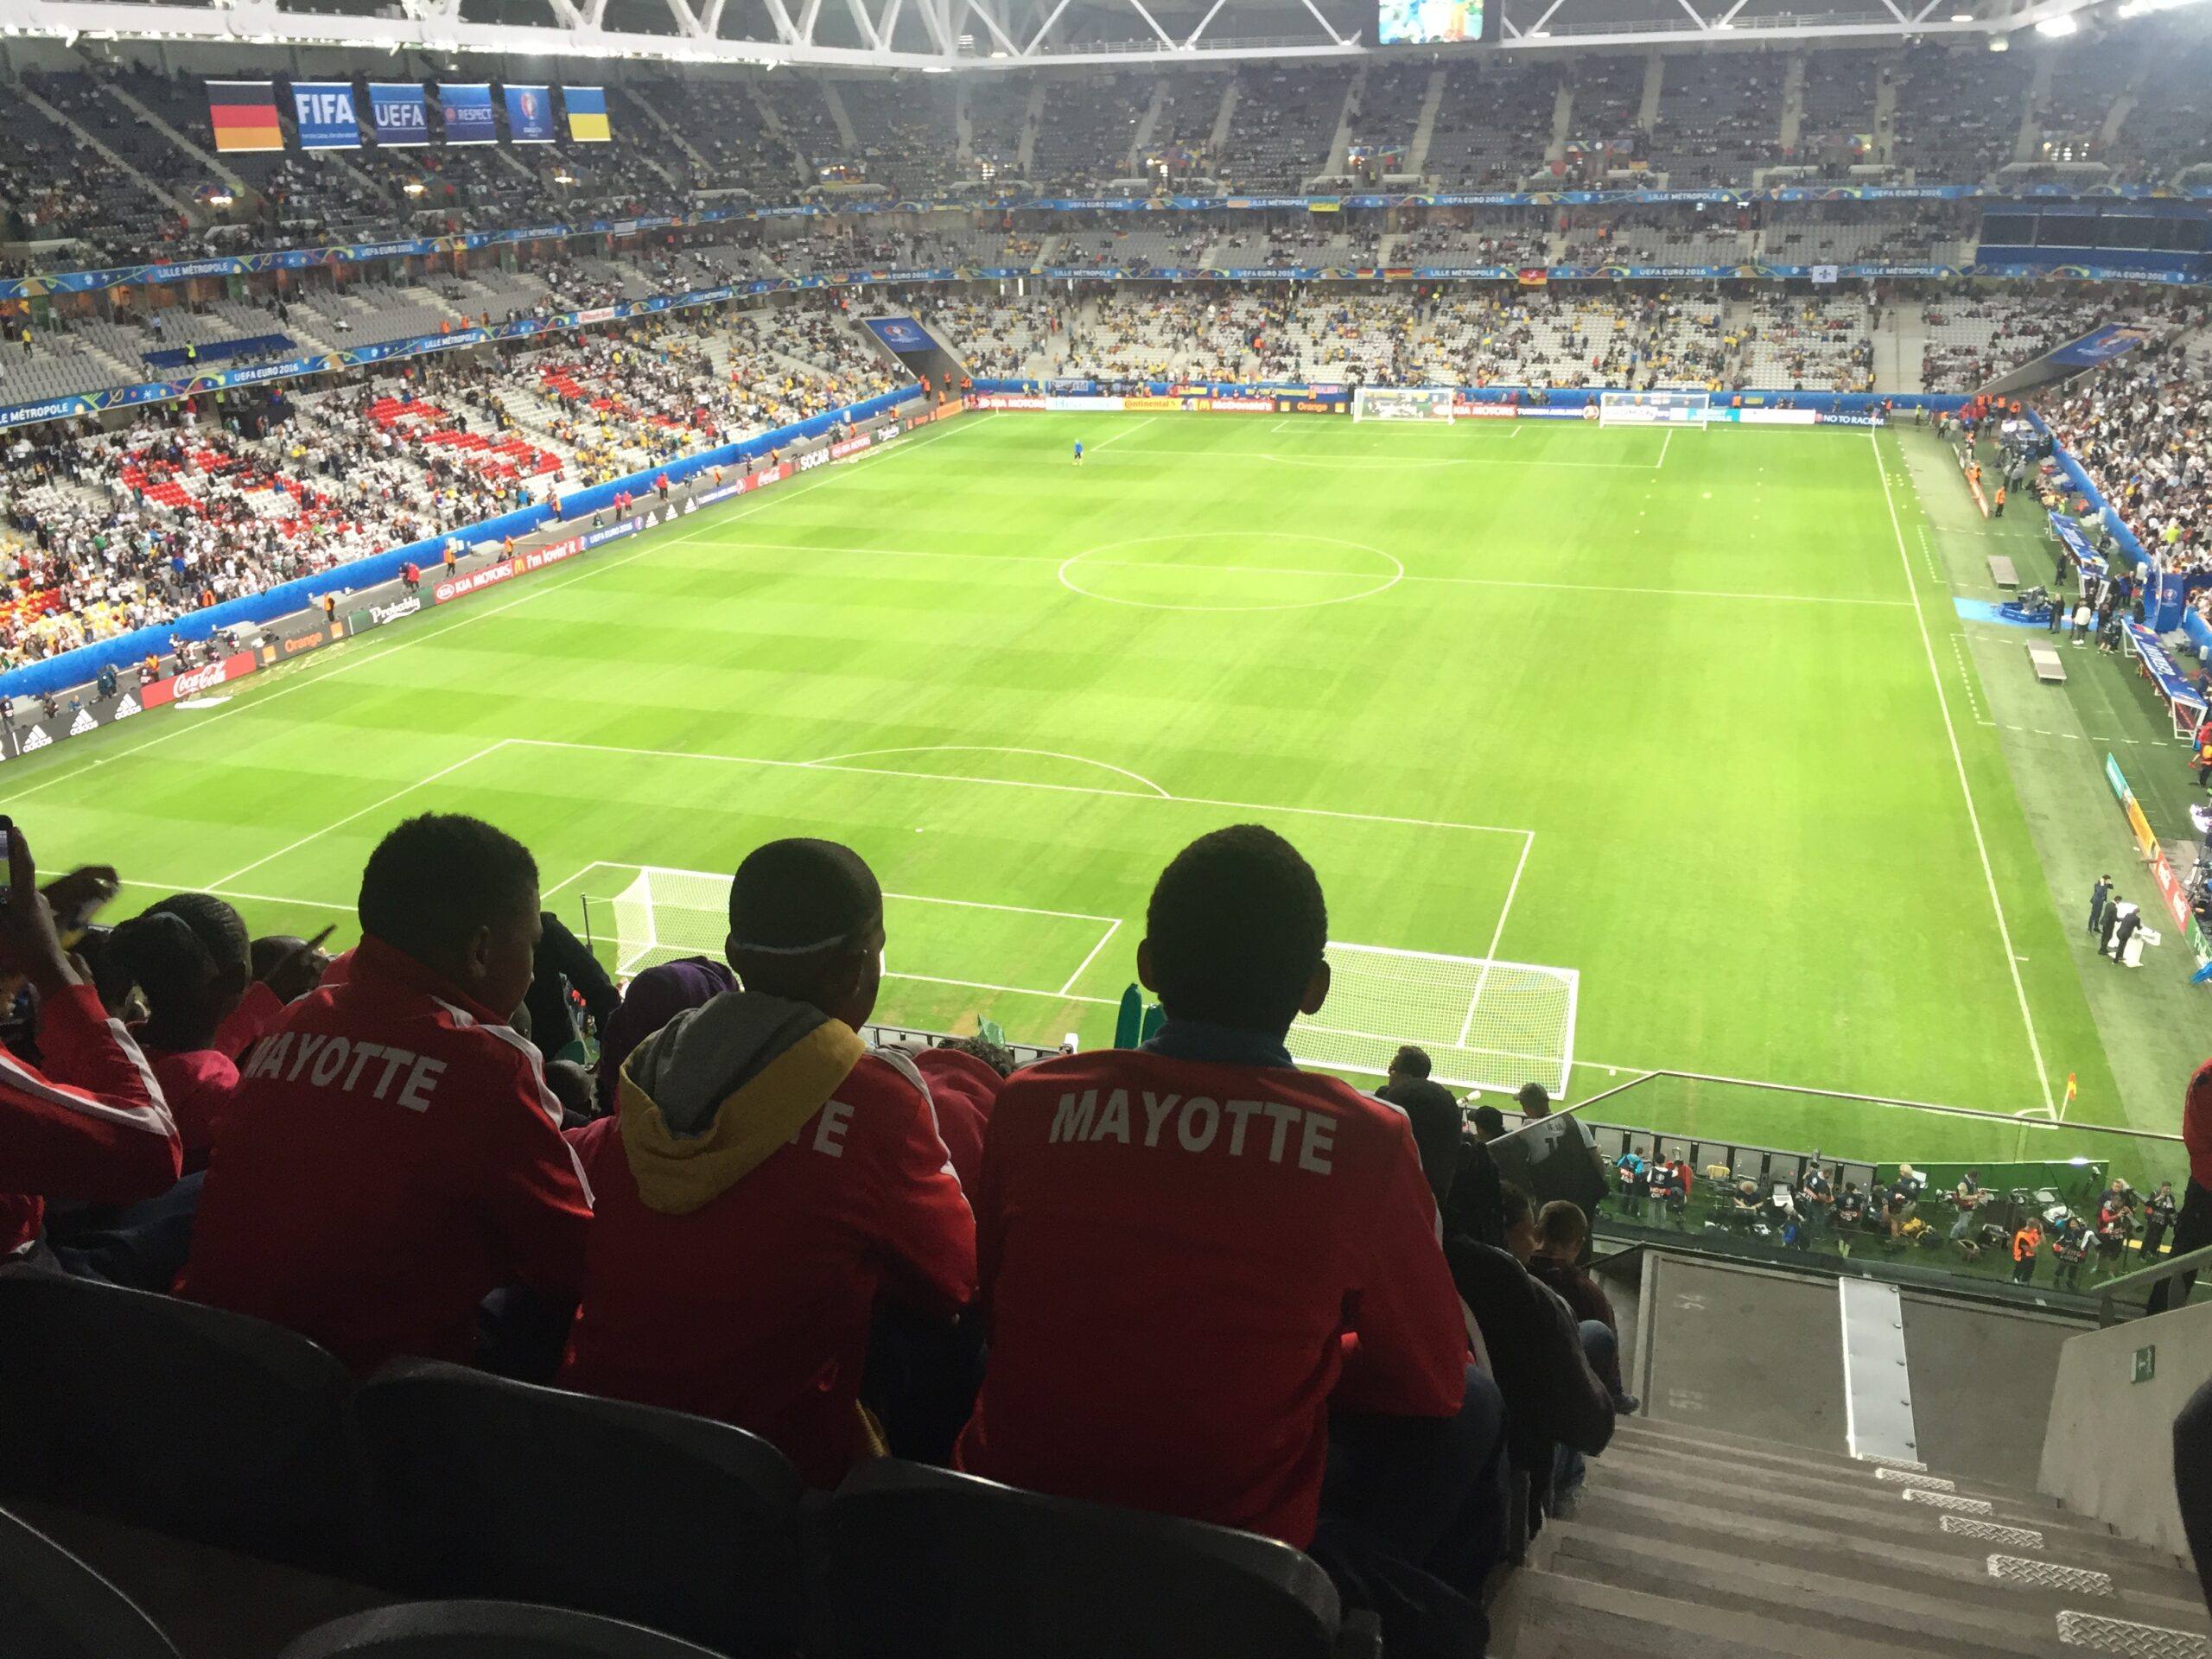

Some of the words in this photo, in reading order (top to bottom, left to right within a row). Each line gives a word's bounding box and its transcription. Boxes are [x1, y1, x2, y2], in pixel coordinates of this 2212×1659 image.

[295, 93, 356, 124] FIFA
[374, 104, 425, 127] UEFA
[458, 99, 493, 121] RESPECT
[234, 370, 257, 382] UEFA
[257, 365, 279, 378] EURO
[278, 362, 299, 374] 2016
[10, 402, 69, 423] MÉTROPOLE
[1297, 402, 1328, 412] Orange
[1823, 415, 1838, 423] NO
[1839, 416, 1851, 424] TO
[800, 448, 830, 471] SOCAR
[589, 531, 605, 543] UEFA
[526, 554, 542, 569] i'm
[543, 543, 568, 563] lovin'
[569, 540, 576, 553] it
[454, 578, 473, 594] KIA
[473, 563, 512, 587] MOTORS
[369, 596, 421, 624] Probably
[284, 632, 323, 653] Orange
[173, 660, 227, 698] Coca-Cola
[114, 704, 143, 721] adidas
[70, 720, 99, 736] adidas
[22, 736, 53, 753] adidas
[1049, 1089, 1338, 1175] MAYOTTE
